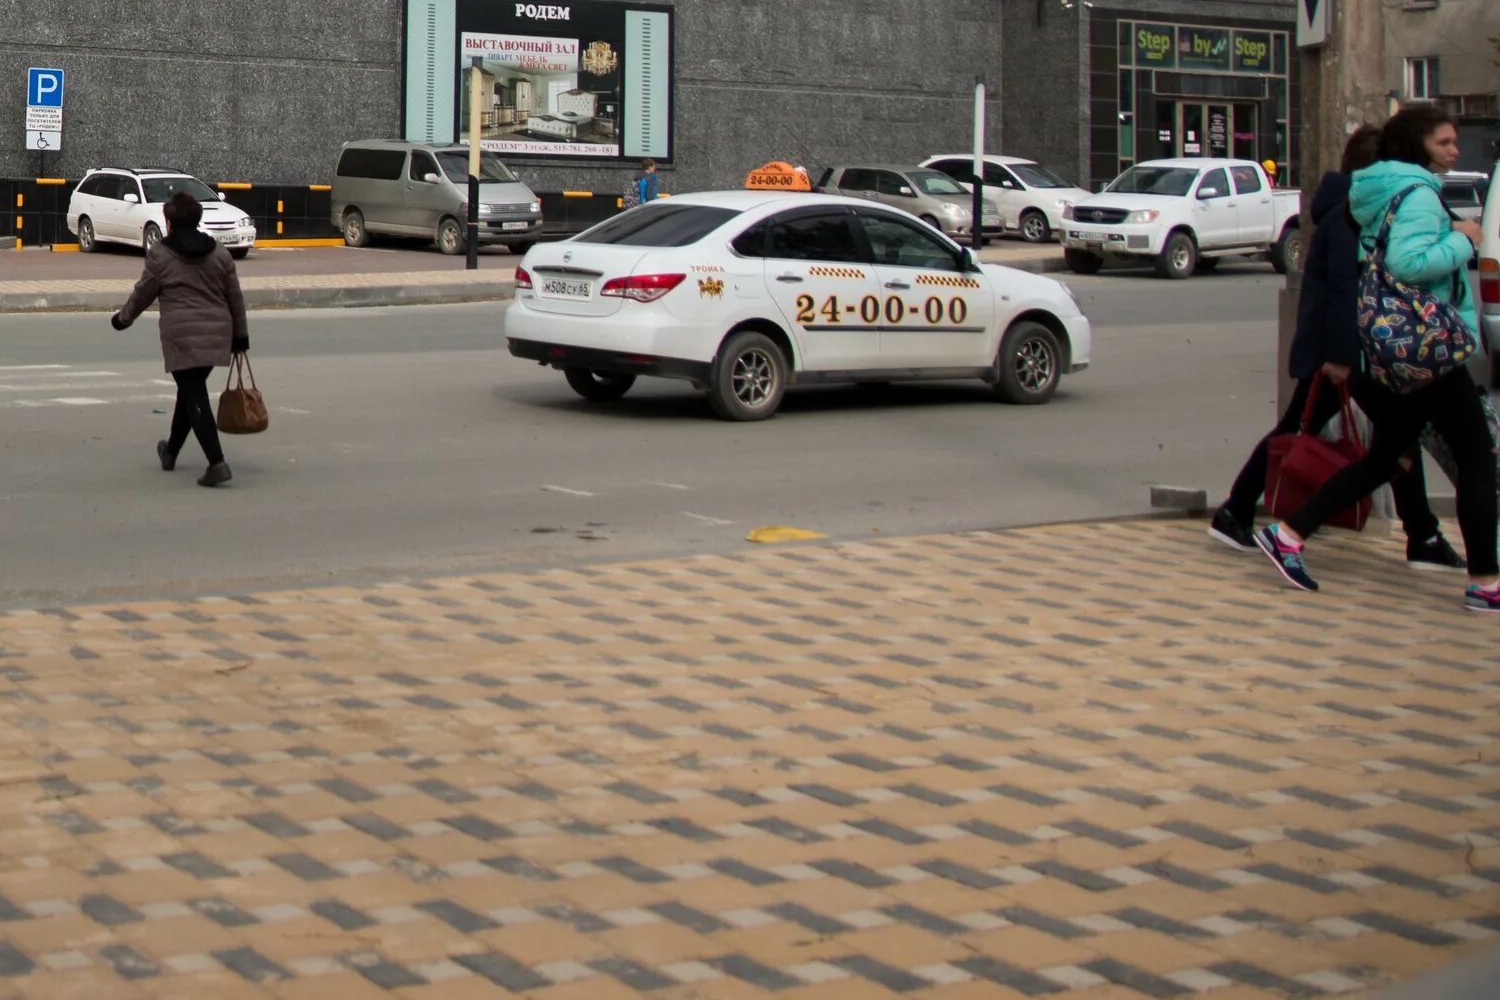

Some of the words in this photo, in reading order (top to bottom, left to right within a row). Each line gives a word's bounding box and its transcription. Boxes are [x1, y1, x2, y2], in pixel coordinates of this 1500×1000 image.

[515, 3, 570, 21] РОДЕМ
[465, 38, 553, 54] ВЫСТАВОЧНЫЙ
[555, 43, 576, 55] ЗАЛ
[1138, 29, 1170, 53] Step
[1194, 33, 1211, 57] by
[1236, 36, 1266, 58] Step
[750, 176, 793, 186] 24-00-00
[796, 294, 967, 325] 24-00-00
